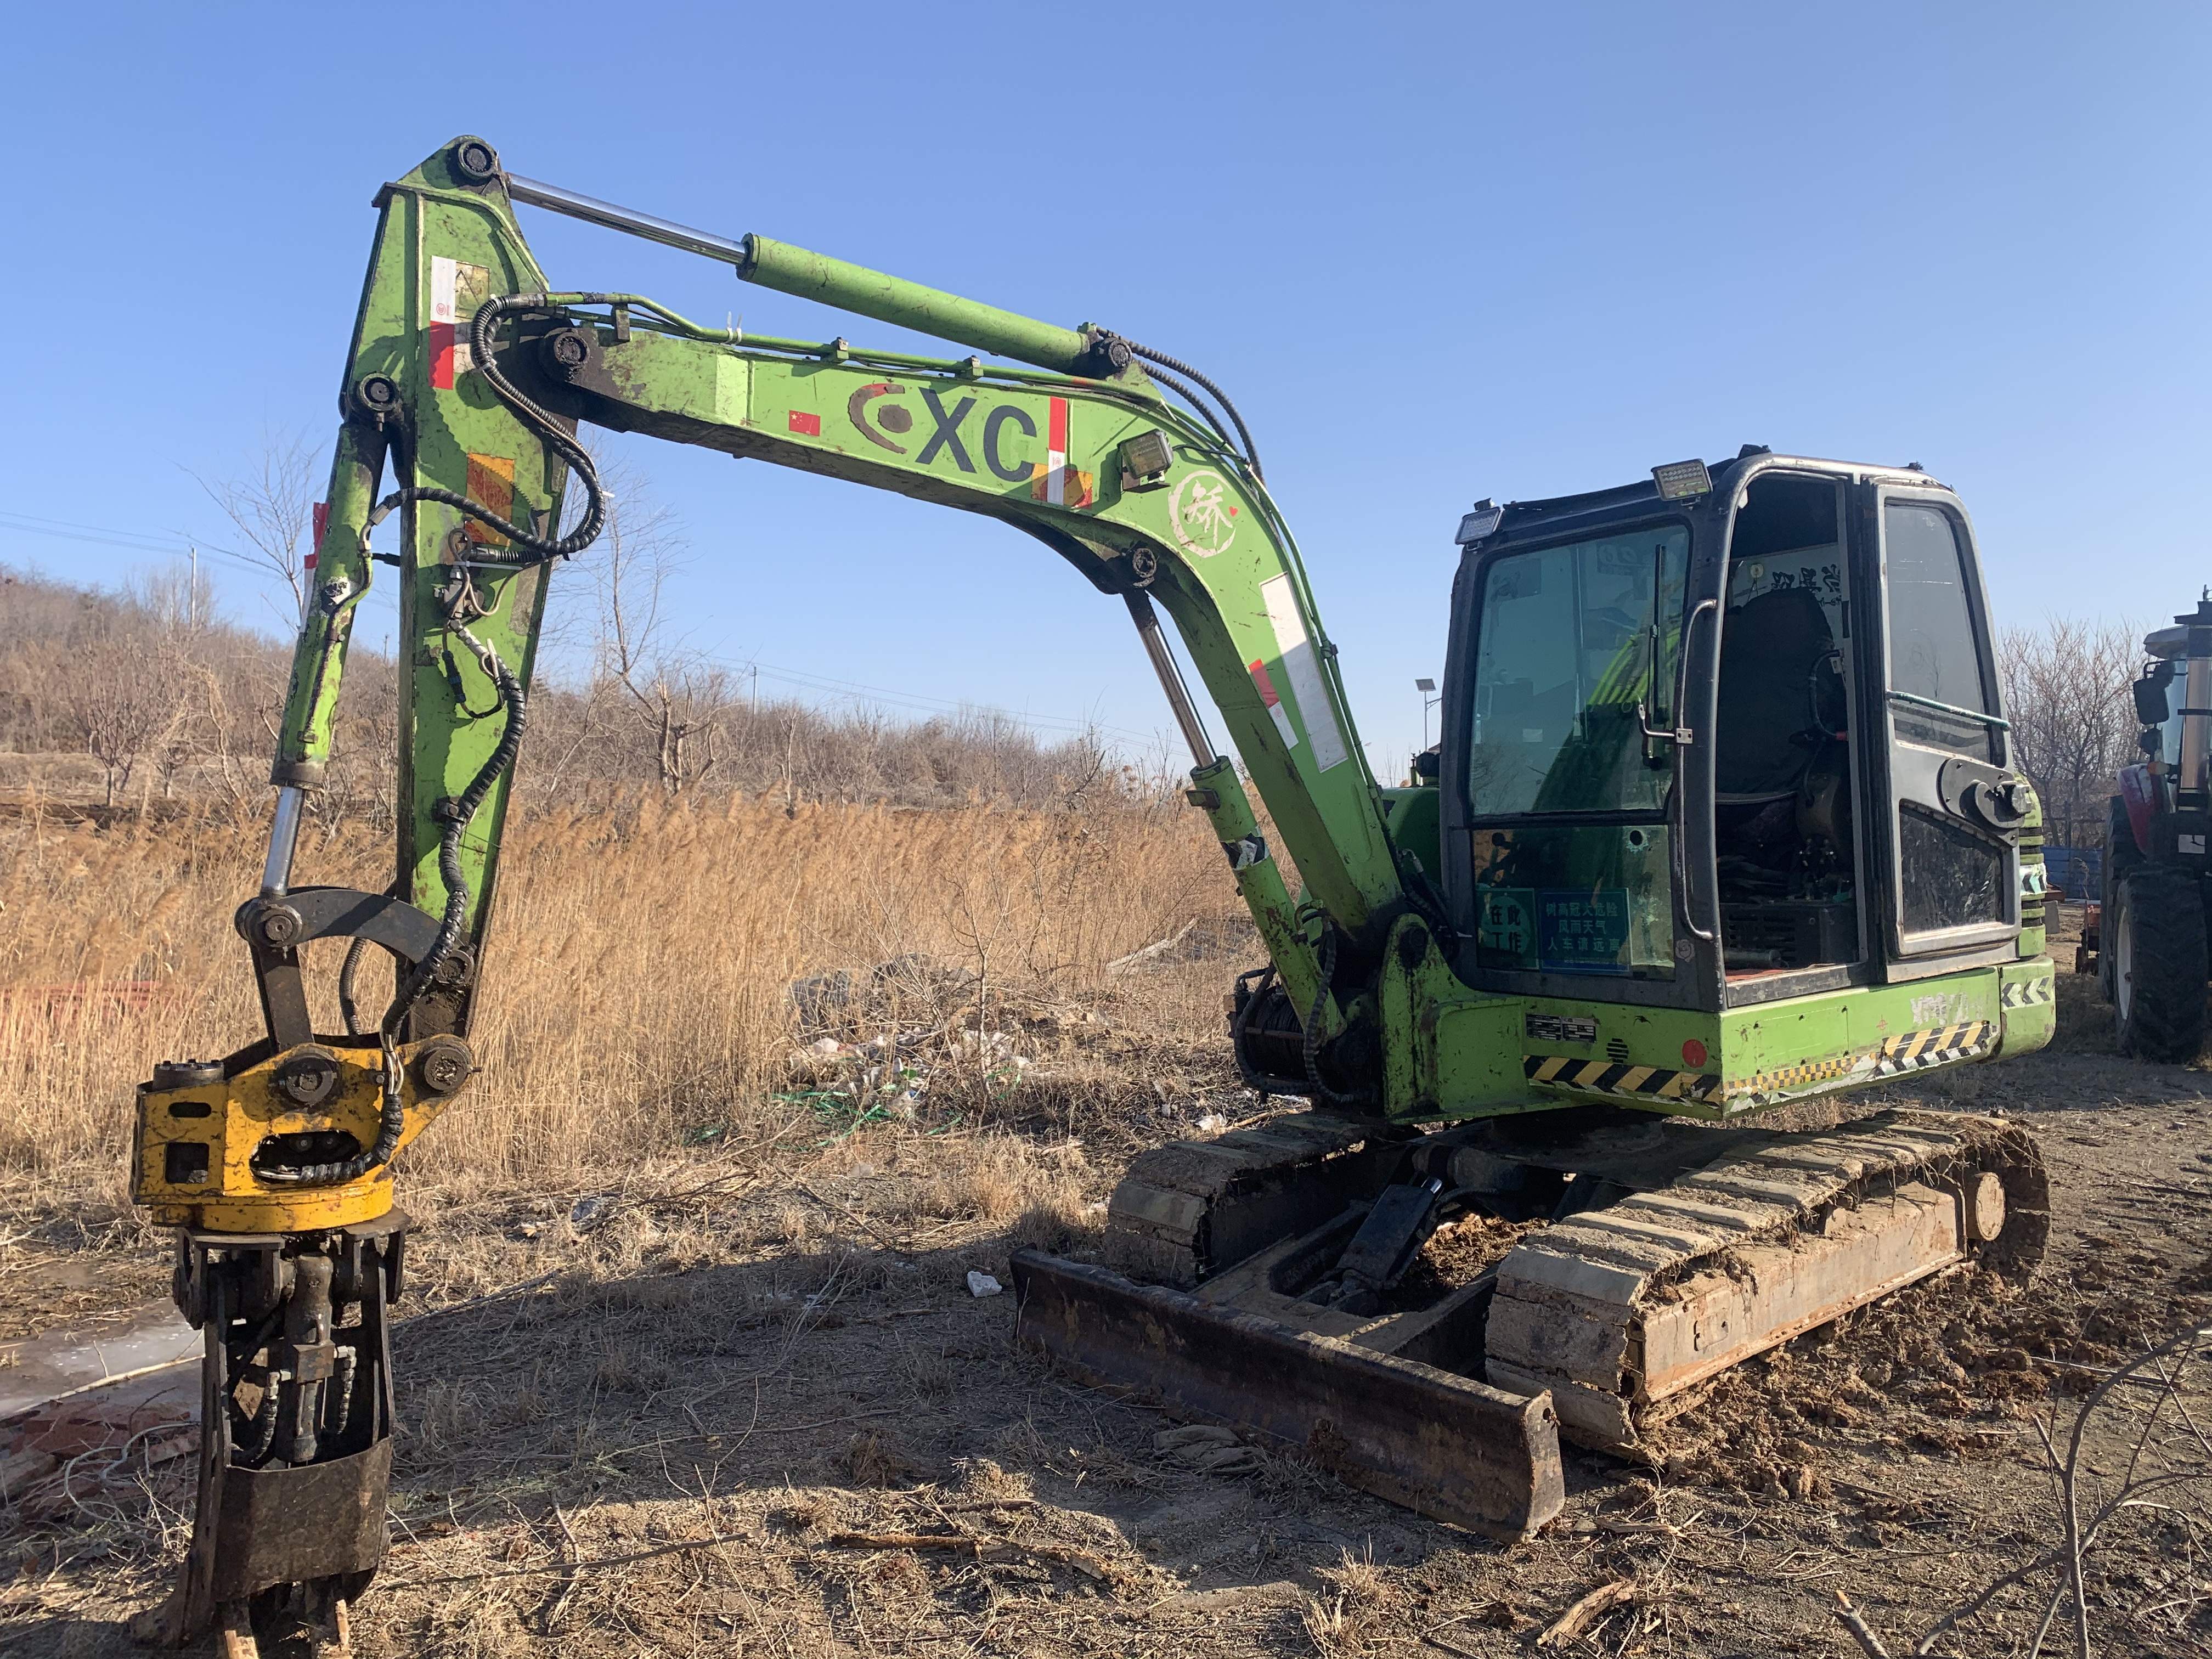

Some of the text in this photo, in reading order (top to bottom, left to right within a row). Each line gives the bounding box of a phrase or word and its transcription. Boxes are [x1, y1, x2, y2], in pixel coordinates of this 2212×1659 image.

[1489, 904, 1521, 927] 在此
[1558, 919, 1607, 934] 风雨天气
[1491, 932, 1522, 953] 工作
[1547, 937, 1620, 953] 人车请远离
